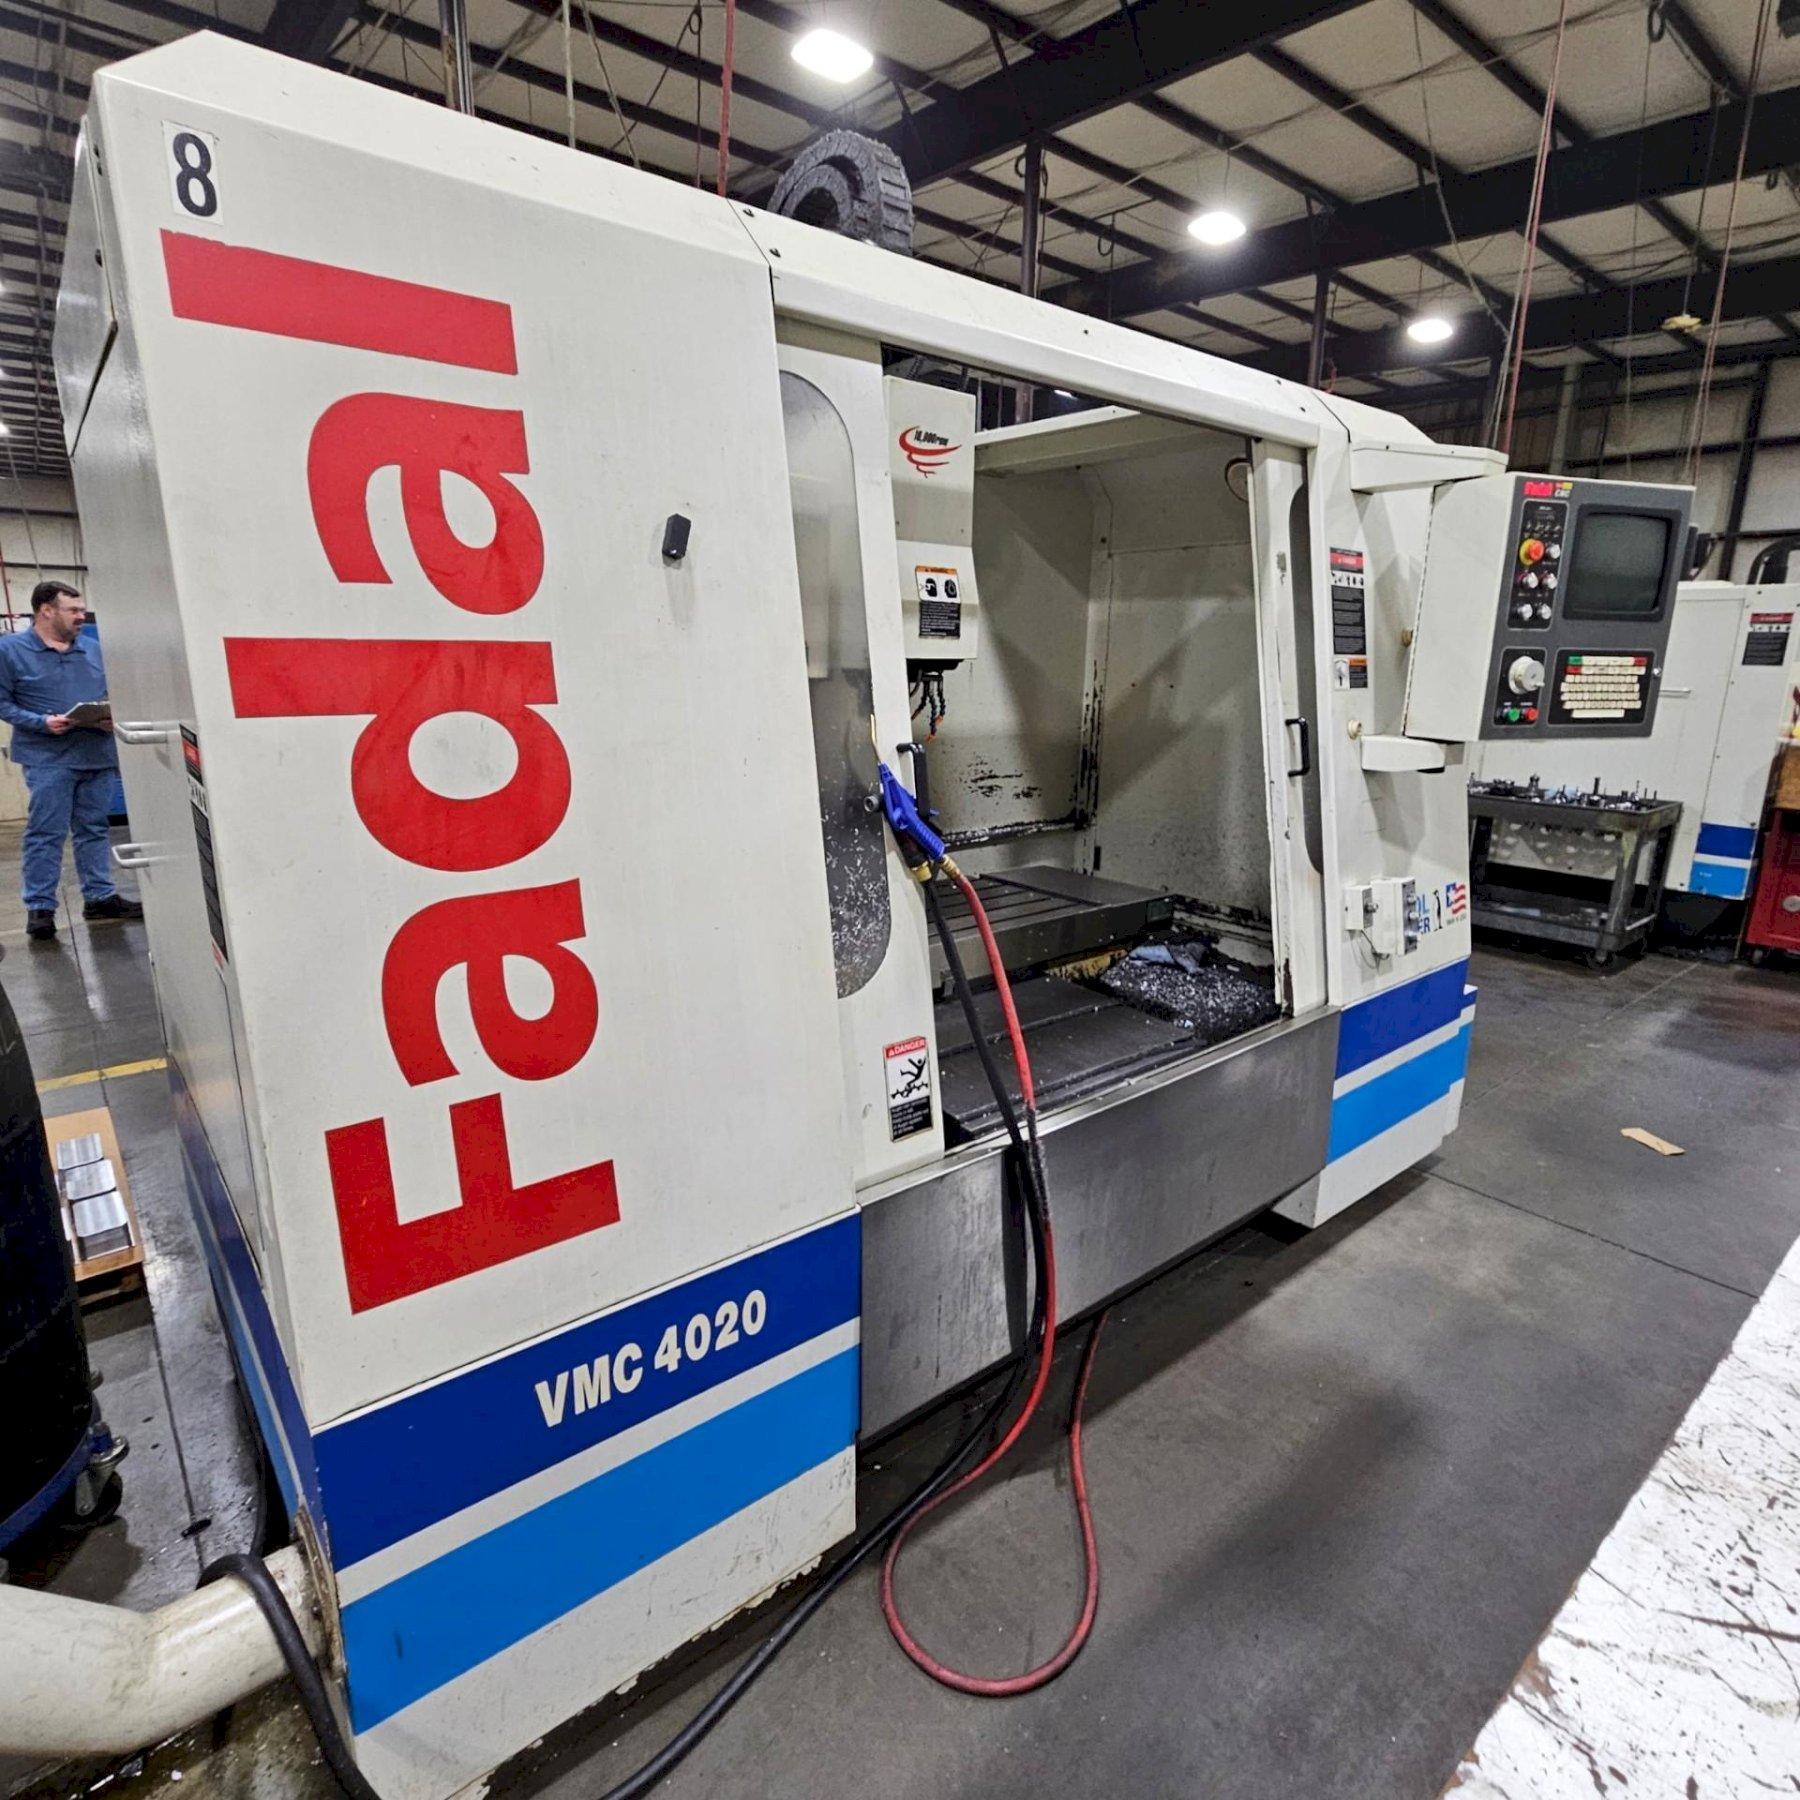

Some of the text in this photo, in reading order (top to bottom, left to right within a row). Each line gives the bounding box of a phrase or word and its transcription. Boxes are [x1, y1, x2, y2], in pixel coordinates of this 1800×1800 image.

[174, 132, 218, 218] 8
[160, 230, 621, 1311] Fadal
[894, 1039, 925, 1053] DANGER
[534, 1289, 767, 1428] VMC 4020
